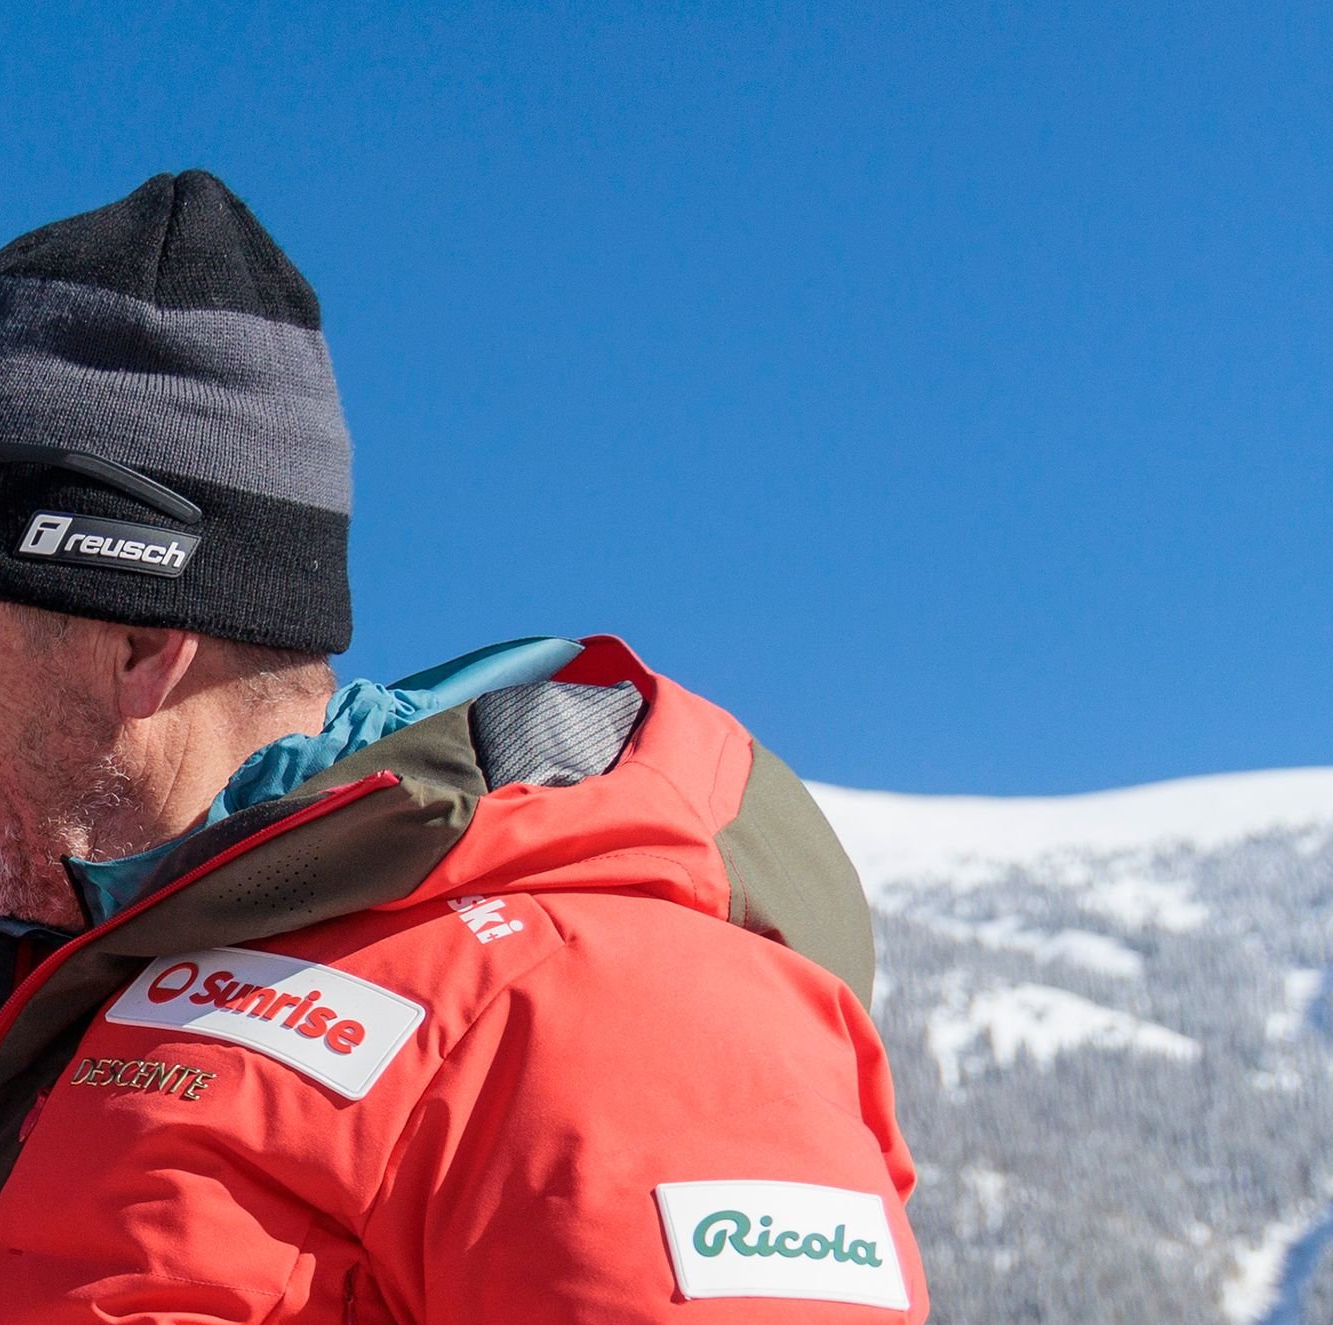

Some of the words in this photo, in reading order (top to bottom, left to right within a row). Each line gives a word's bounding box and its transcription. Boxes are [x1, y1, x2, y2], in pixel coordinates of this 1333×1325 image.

[64, 533, 185, 567] reusch
[189, 970, 366, 1055] Sunrise
[71, 1058, 218, 1101] DESCENTE
[692, 1210, 883, 1268] Ricola
